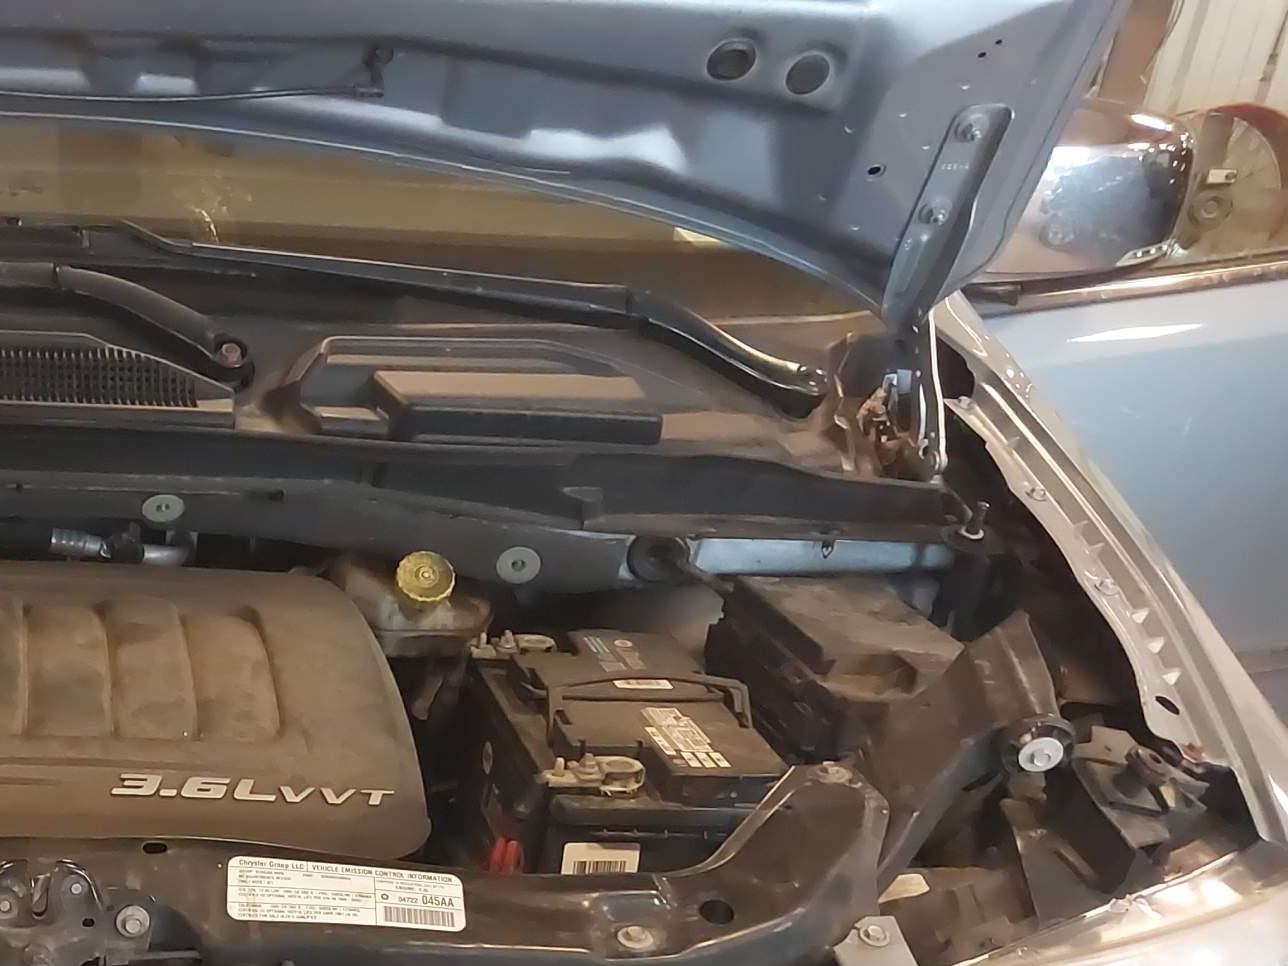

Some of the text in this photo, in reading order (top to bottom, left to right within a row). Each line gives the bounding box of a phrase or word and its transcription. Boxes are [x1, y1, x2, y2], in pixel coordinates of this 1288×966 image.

[111, 773, 396, 806] 3.6L VVT
[238, 859, 266, 868] Chrysler
[269, 861, 289, 870] Group
[312, 864, 453, 883] VEHICLE EMISSION CONTROL INFORMATION
[422, 895, 455, 907] 045AA
